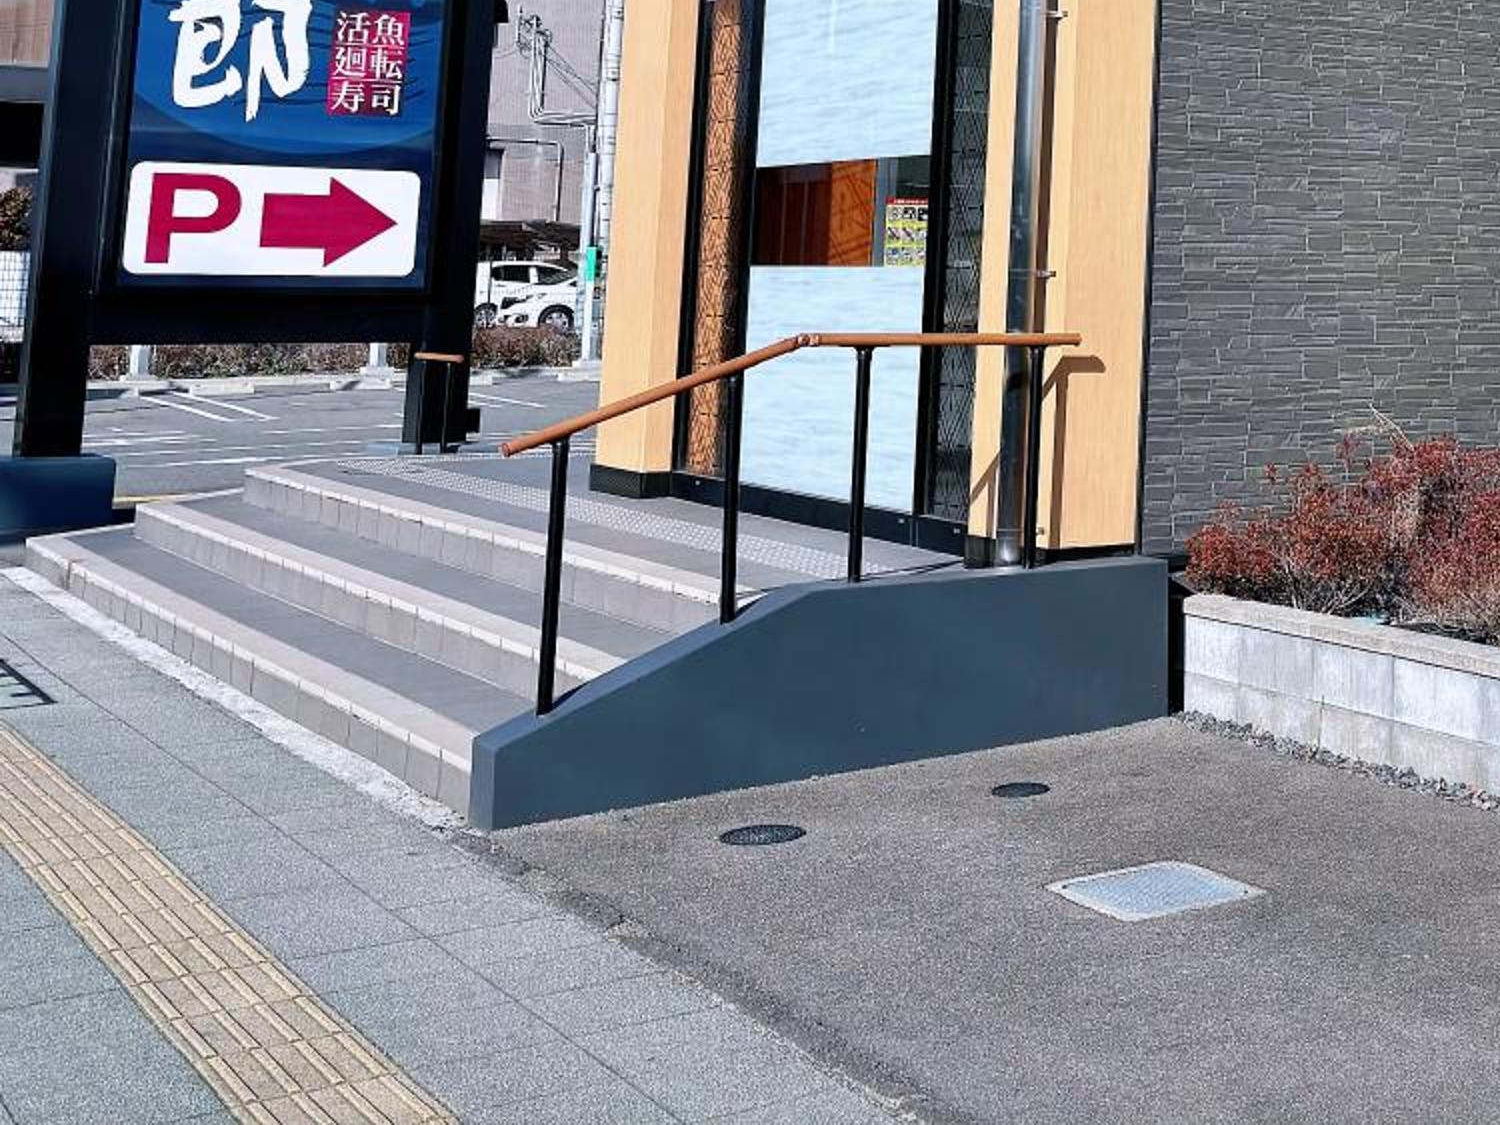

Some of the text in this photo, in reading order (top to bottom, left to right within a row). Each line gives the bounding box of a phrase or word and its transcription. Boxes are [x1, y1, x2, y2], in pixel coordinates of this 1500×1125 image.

[336, 10, 405, 46] 活魚
[334, 46, 403, 80] 廻転
[331, 80, 402, 116] 寿司
[144, 171, 243, 264] P
